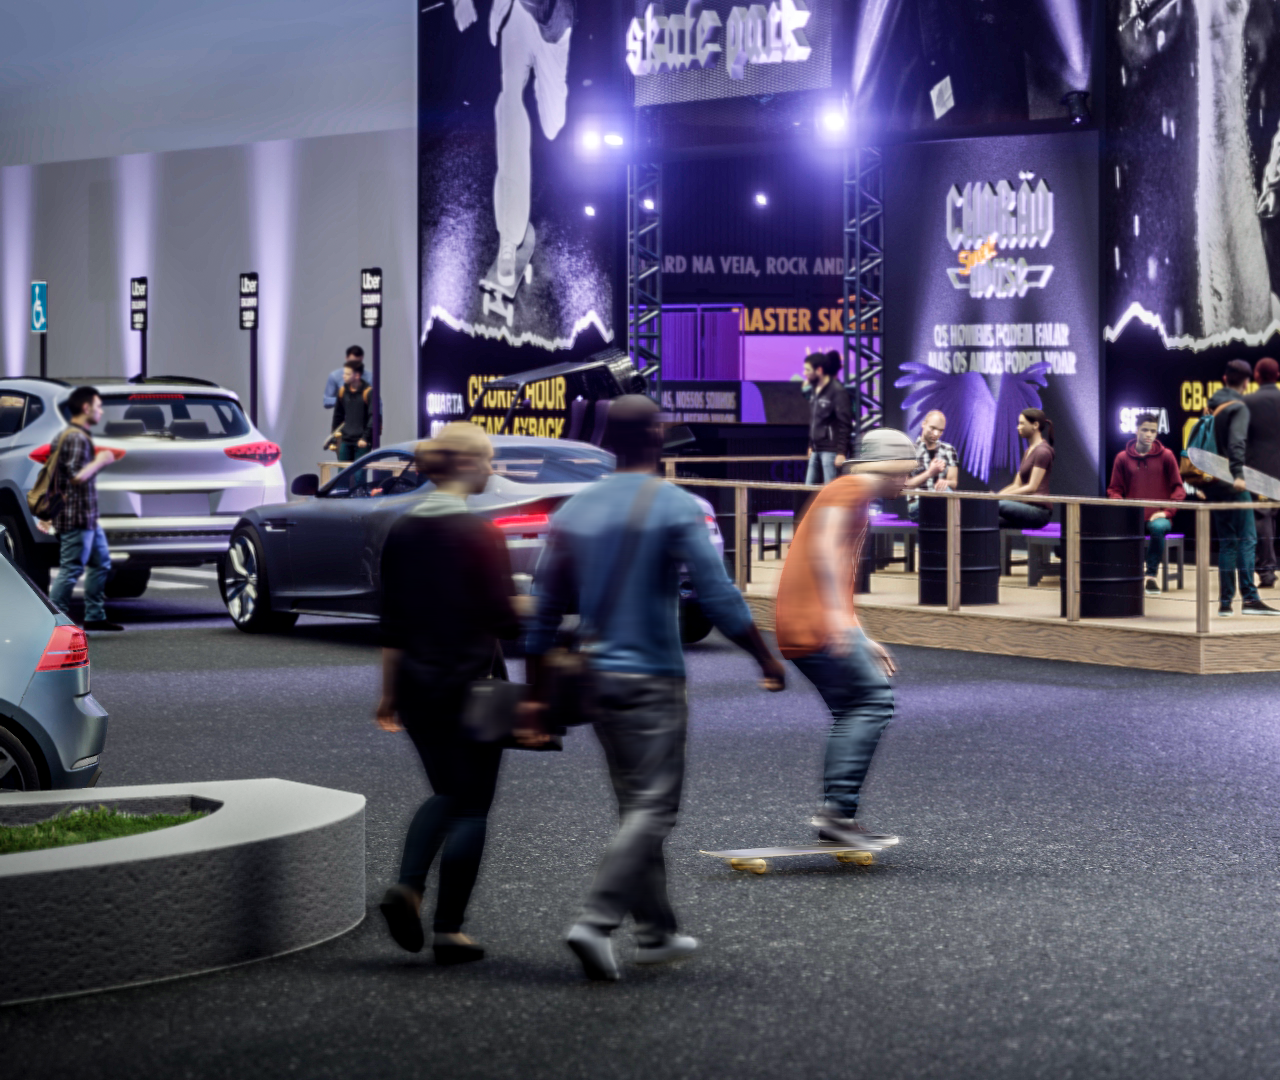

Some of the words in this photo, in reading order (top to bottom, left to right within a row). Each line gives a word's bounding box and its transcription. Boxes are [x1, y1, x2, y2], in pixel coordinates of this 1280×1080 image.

[692, 254, 716, 275] NA
[720, 255, 761, 278] VEIA,
[766, 255, 808, 276] ROCK
[813, 256, 845, 276] AND
[362, 272, 381, 290] Uber
[426, 393, 465, 416] QUARTA
[524, 375, 567, 410] HOUR
[506, 416, 566, 440] AYBACK
